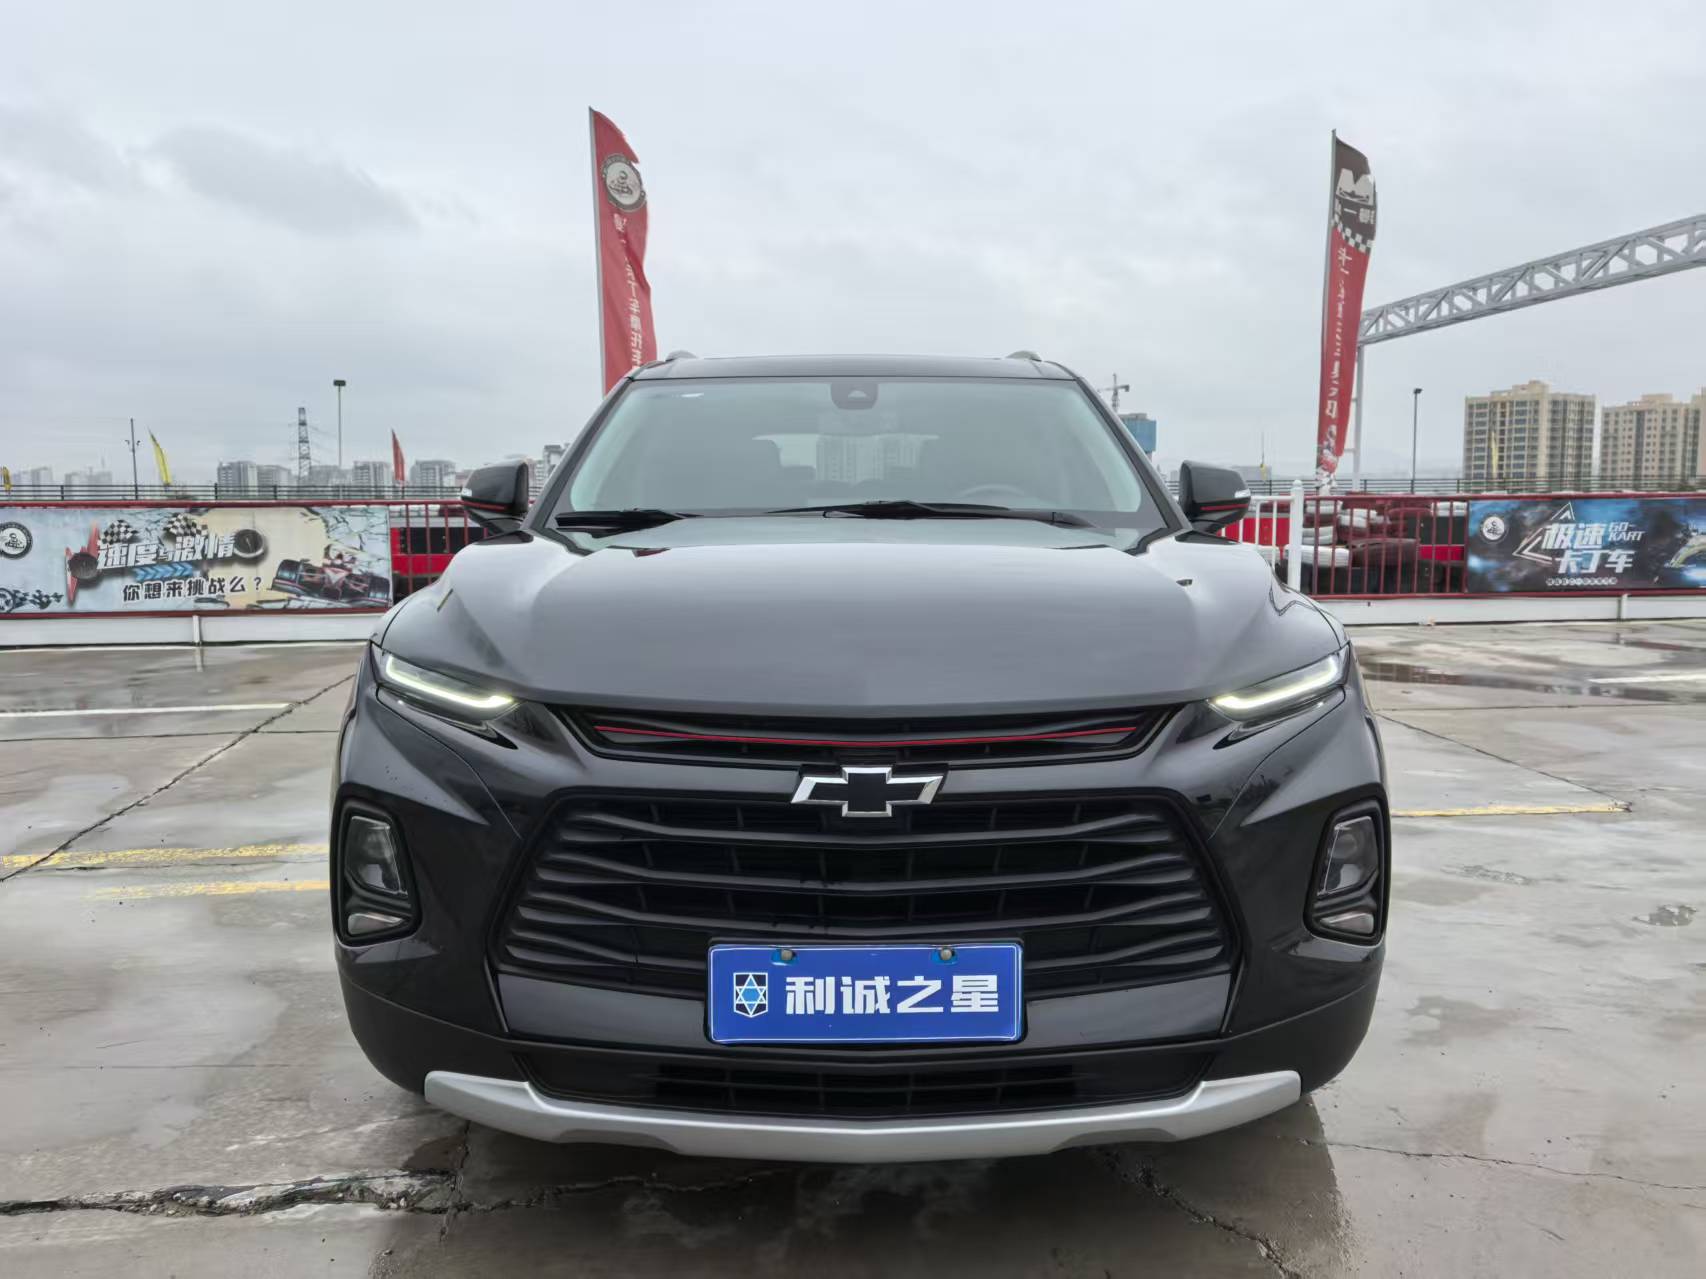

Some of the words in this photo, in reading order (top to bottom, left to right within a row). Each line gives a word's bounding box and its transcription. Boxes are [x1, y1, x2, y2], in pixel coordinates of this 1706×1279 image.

[1541, 522, 1607, 549] 极速
[1608, 531, 1645, 541] KART
[97, 532, 235, 570] 速度与激情
[1554, 548, 1635, 574] 卡丁车
[785, 975, 999, 1015] 利诚之星
